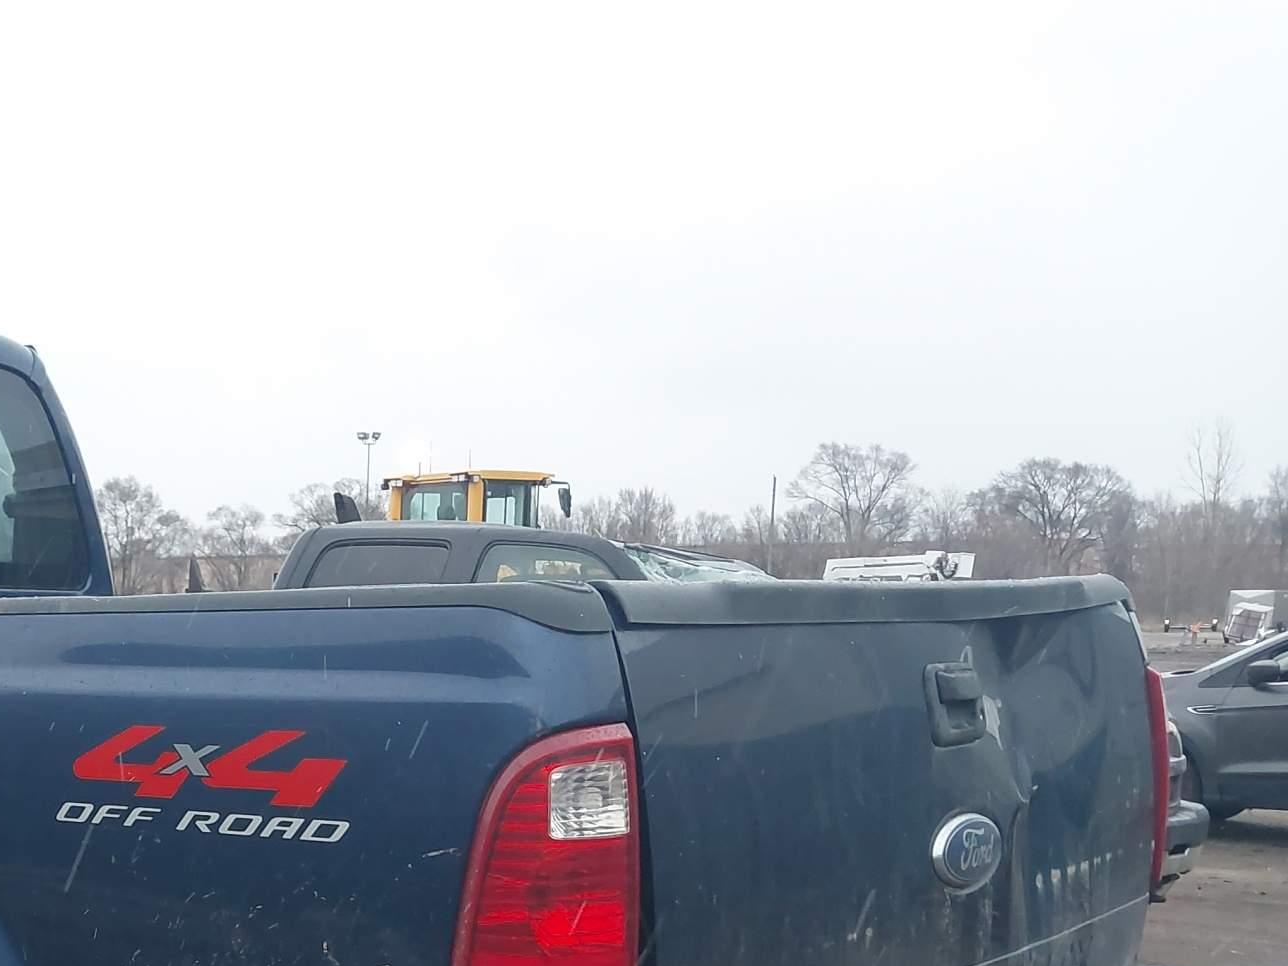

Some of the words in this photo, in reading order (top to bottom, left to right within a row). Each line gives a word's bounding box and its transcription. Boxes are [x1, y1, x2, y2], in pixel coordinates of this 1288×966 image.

[55, 801, 162, 828] OFF
[175, 810, 351, 843] ROAD
[960, 827, 995, 871] Ford
